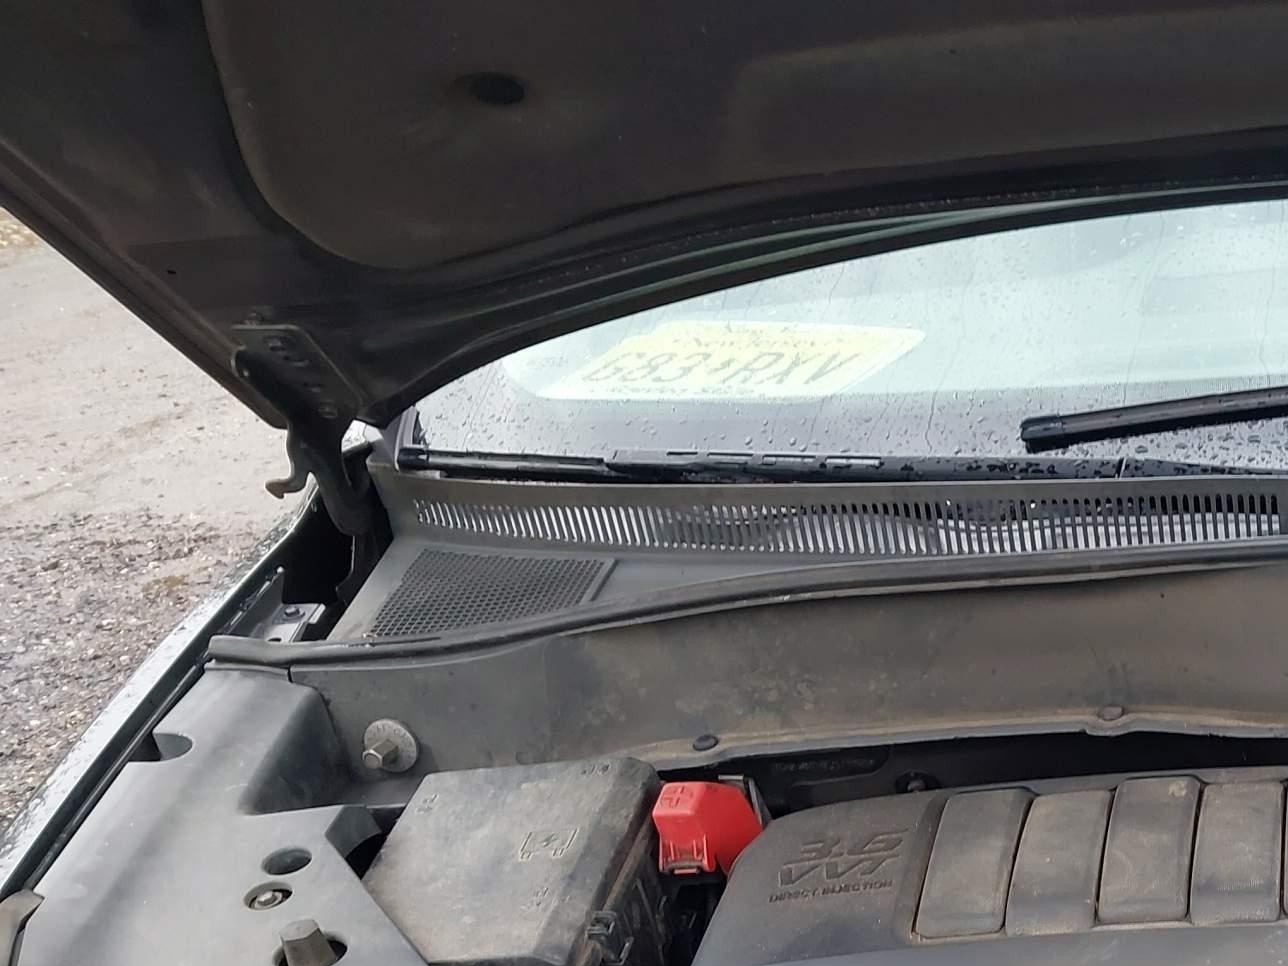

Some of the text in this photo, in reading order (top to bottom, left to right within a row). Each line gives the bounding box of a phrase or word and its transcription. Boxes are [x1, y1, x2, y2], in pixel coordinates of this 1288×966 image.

[799, 829, 909, 861] 3.6
[777, 853, 901, 887] VVT
[768, 879, 894, 904] DIRECT INJECTION
